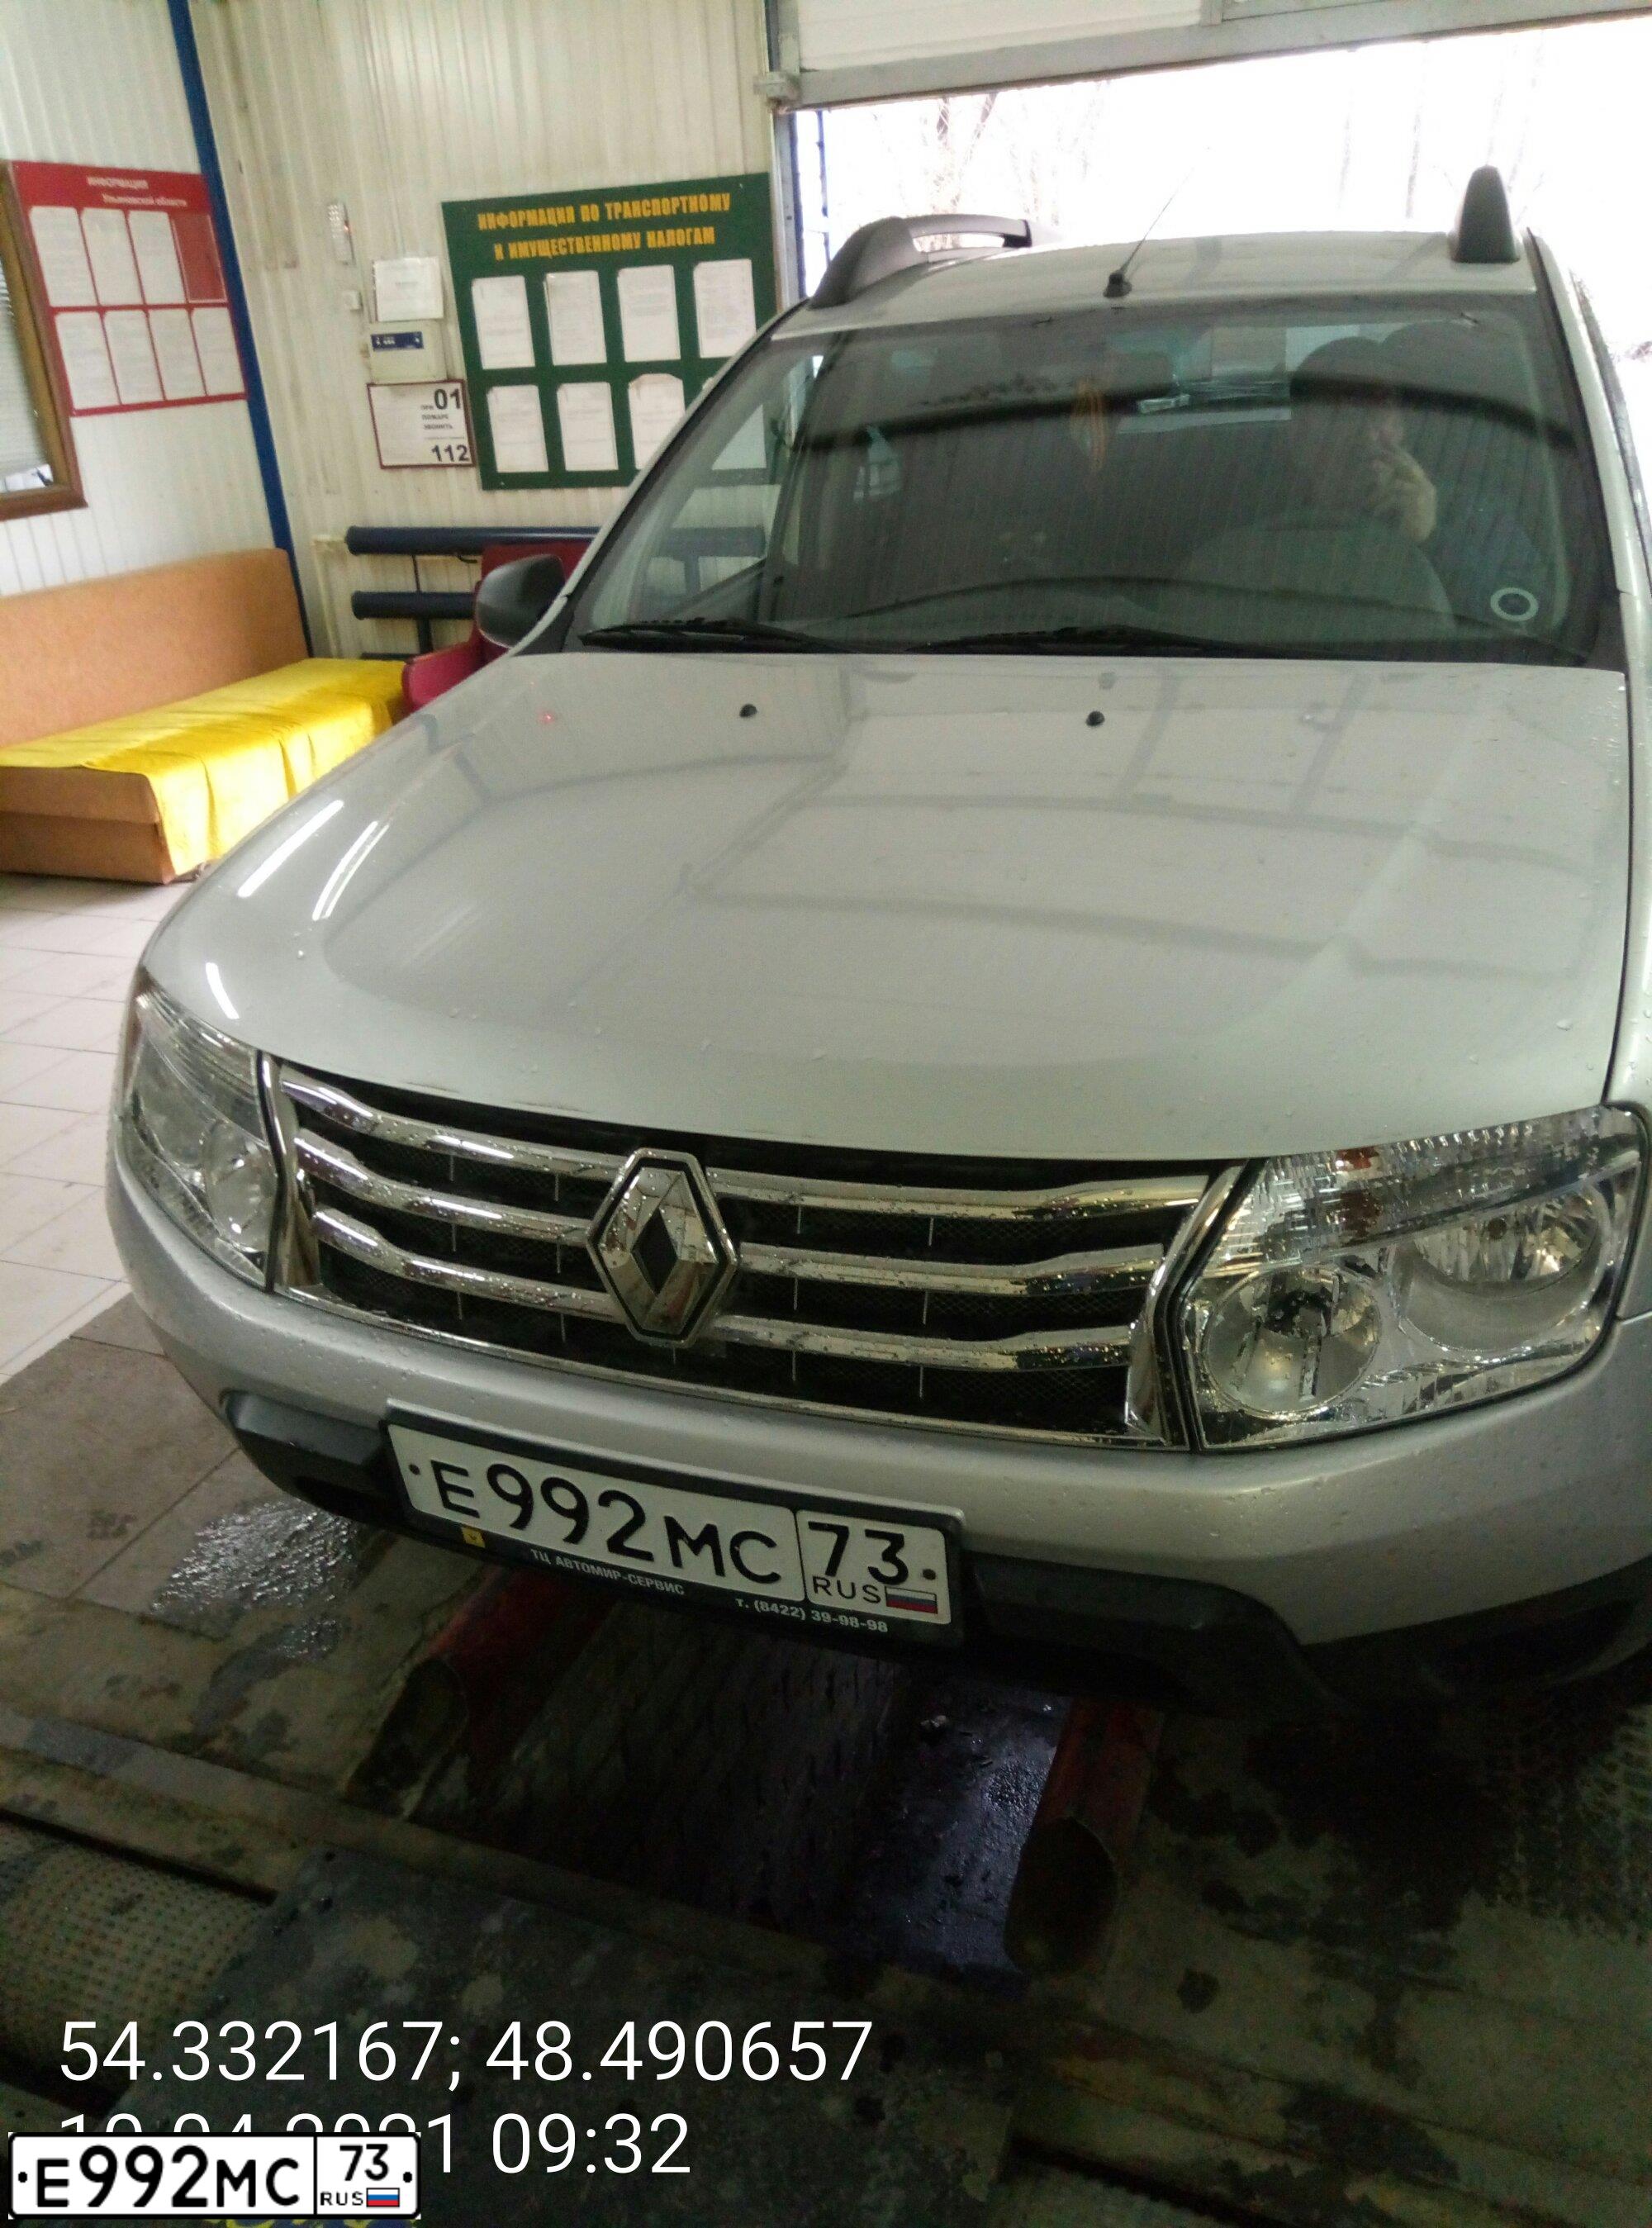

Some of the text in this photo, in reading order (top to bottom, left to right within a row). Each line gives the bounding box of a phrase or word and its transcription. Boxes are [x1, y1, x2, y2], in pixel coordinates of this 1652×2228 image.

[477, 192, 730, 230] ИНФОРМАЦИЯ ПО ТРАНСПОРТНОМУ
[508, 231, 641, 259] ИМУЩЕСТВЕННОМУ
[647, 226, 715, 249] НАЛОГАМ
[434, 388, 461, 410] 01
[431, 444, 469, 462] 112
[807, 1521, 909, 1586] 73
[530, 1548, 685, 1595] ТЦ АВТОМИР-СЕРВИС
[812, 1575, 881, 1604] RUS
[754, 1600, 805, 1622] (8422)
[811, 1610, 889, 1633] 39-98-98
